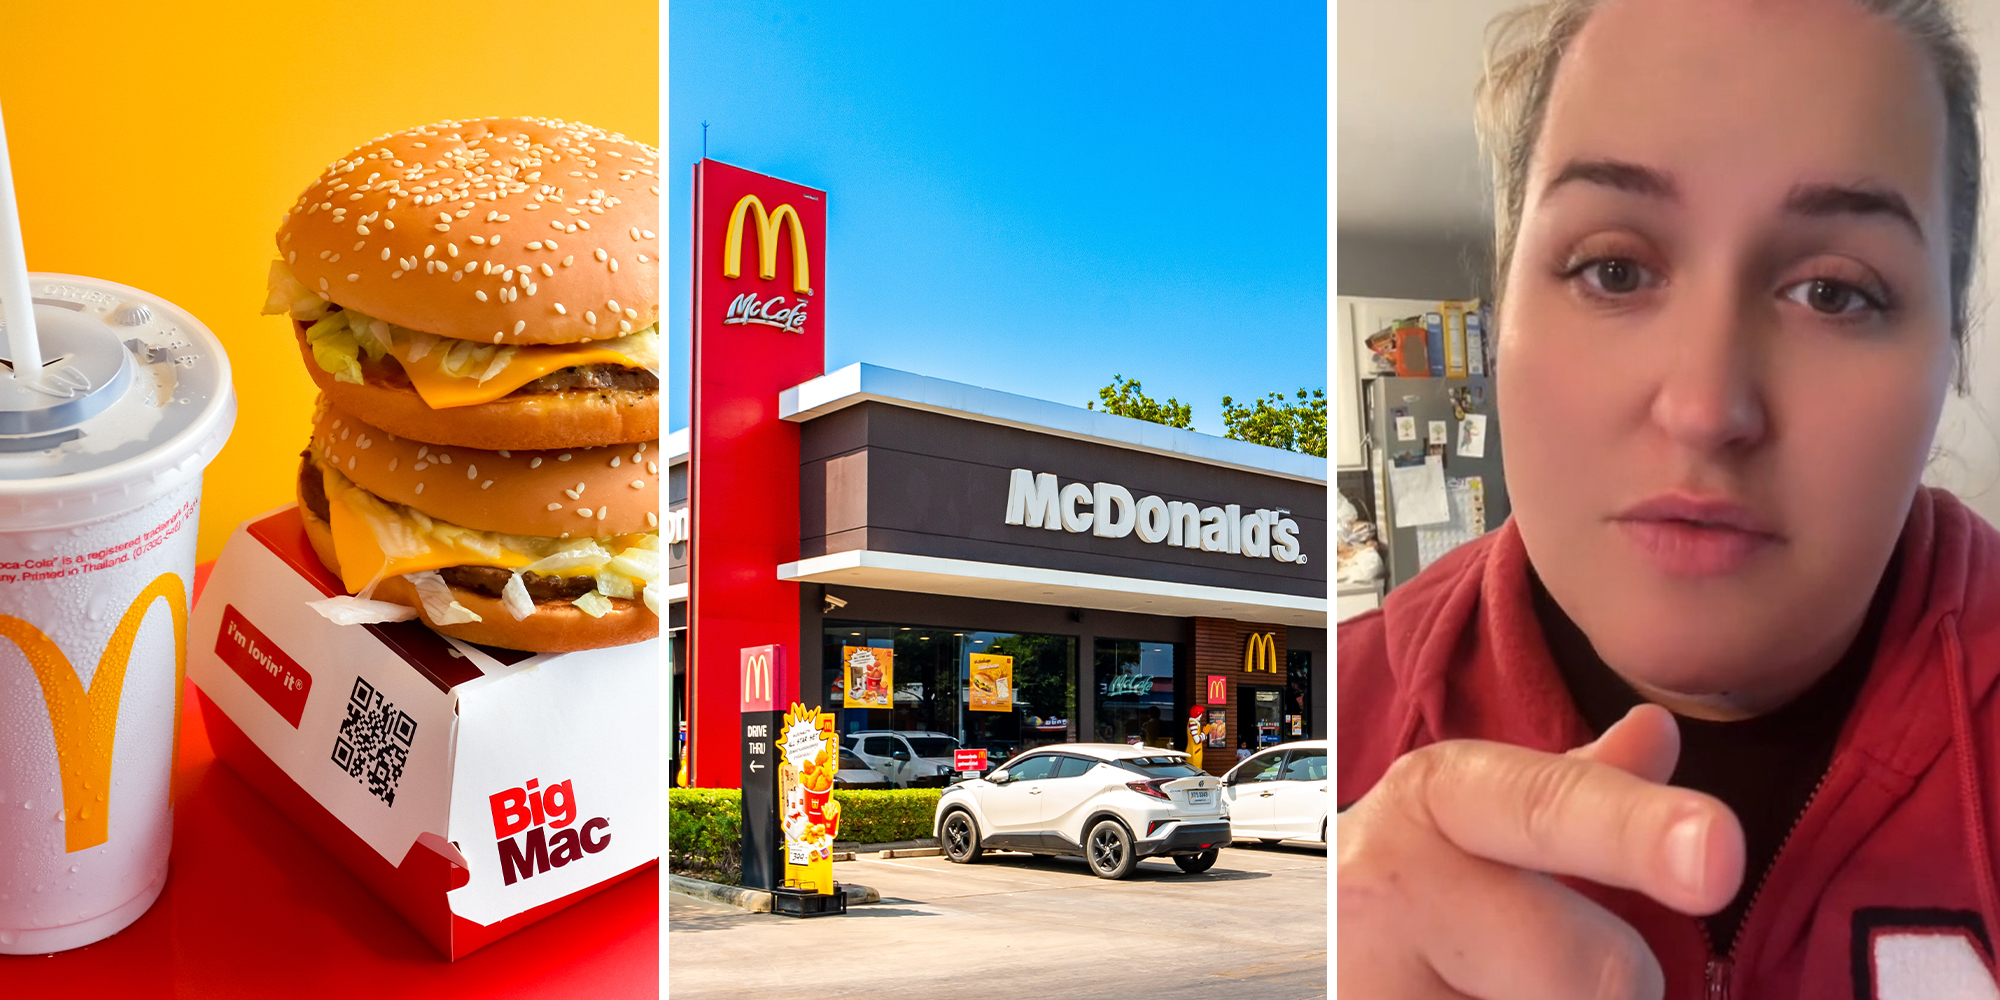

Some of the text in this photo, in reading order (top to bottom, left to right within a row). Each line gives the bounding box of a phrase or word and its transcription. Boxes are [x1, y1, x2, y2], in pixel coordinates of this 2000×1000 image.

[62, 556, 72, 565] is
[76, 555, 84, 563] a
[88, 535, 141, 561] registered
[143, 508, 182, 541] trademark
[1005, 468, 1300, 562] McDonald's
[0, 574, 20, 584] ny.
[22, 570, 64, 581] Printed
[68, 567, 79, 576] in
[81, 554, 130, 573] Thailand.
[227, 620, 246, 648] i'm
[248, 639, 283, 677] lovin'
[747, 725, 768, 738] DRIVE
[748, 742, 766, 754] THRU
[488, 777, 577, 840] Big
[497, 816, 611, 887] Mac
